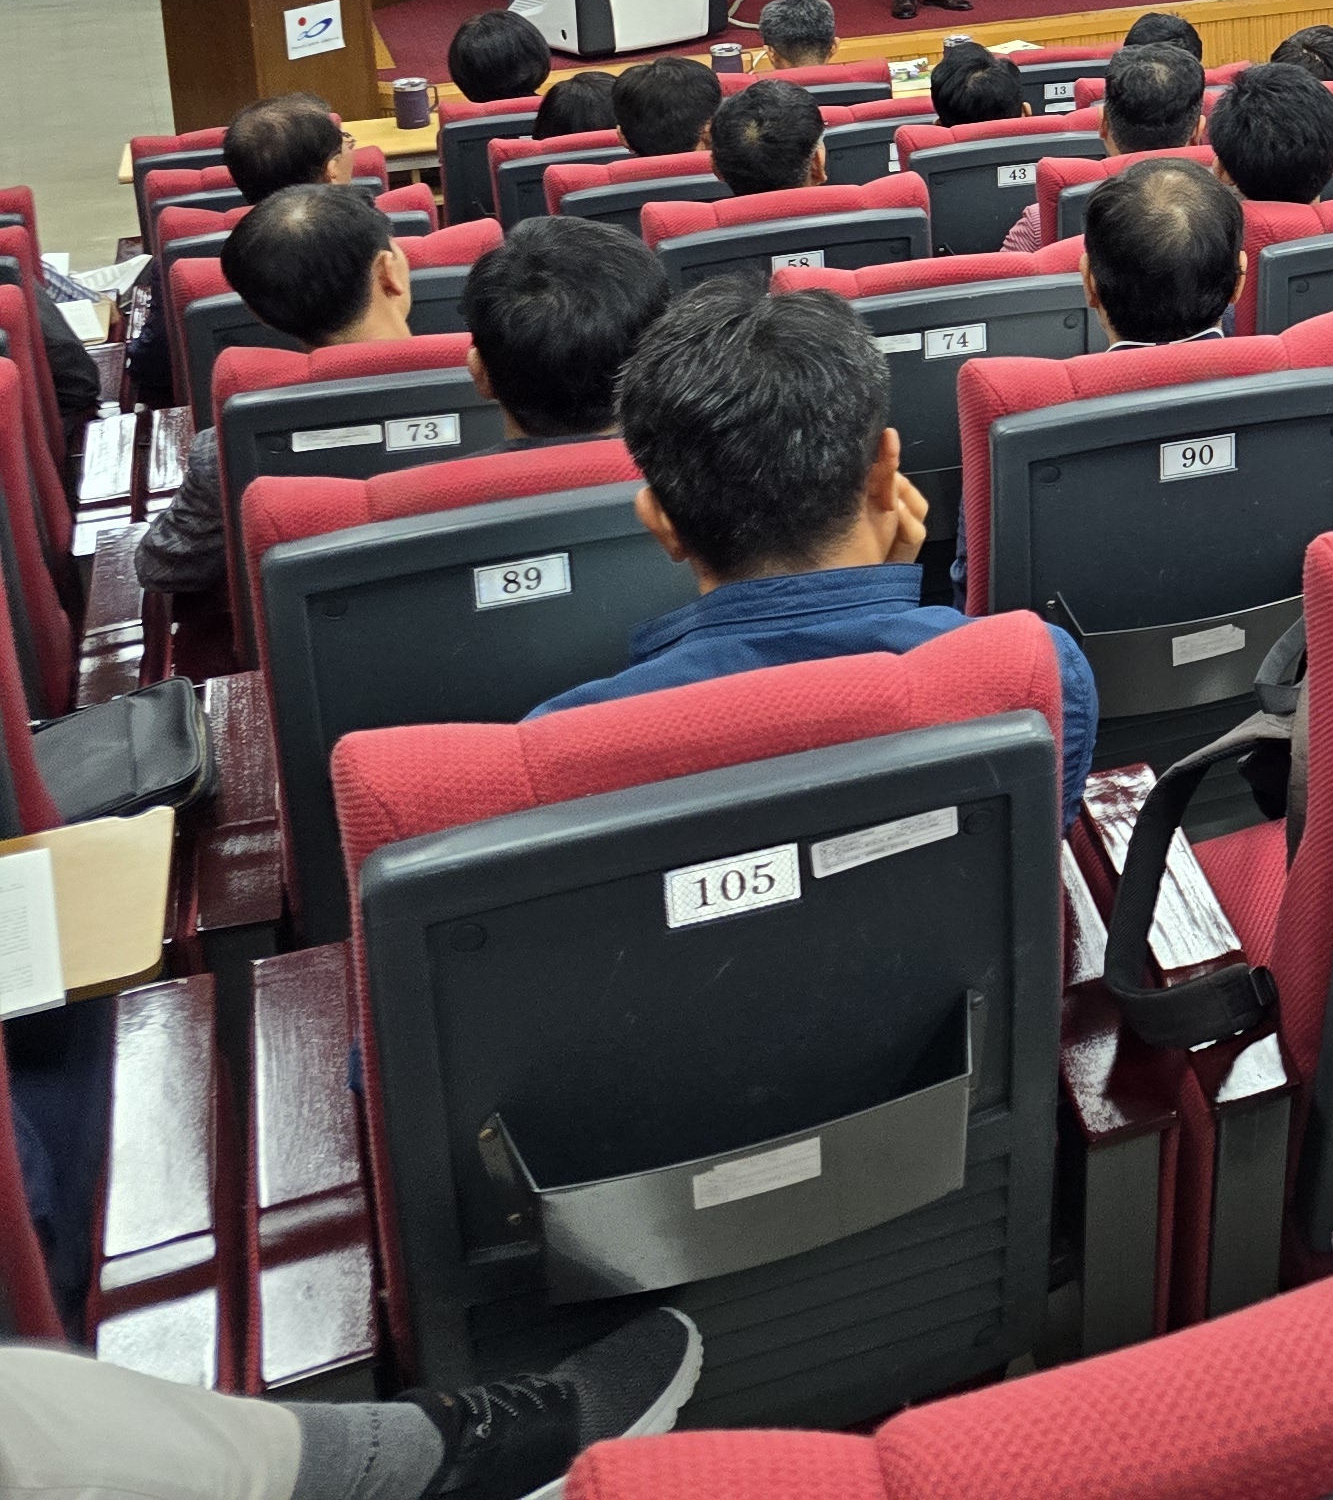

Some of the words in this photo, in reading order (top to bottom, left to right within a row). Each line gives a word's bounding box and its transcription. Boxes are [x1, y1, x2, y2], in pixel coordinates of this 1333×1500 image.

[1053, 86, 1067, 96] 13
[1009, 168, 1027, 180] 43
[942, 331, 969, 350] 74
[406, 421, 439, 442] 73
[1181, 444, 1214, 469] 90
[502, 566, 543, 594] 89
[692, 860, 779, 911] 105
